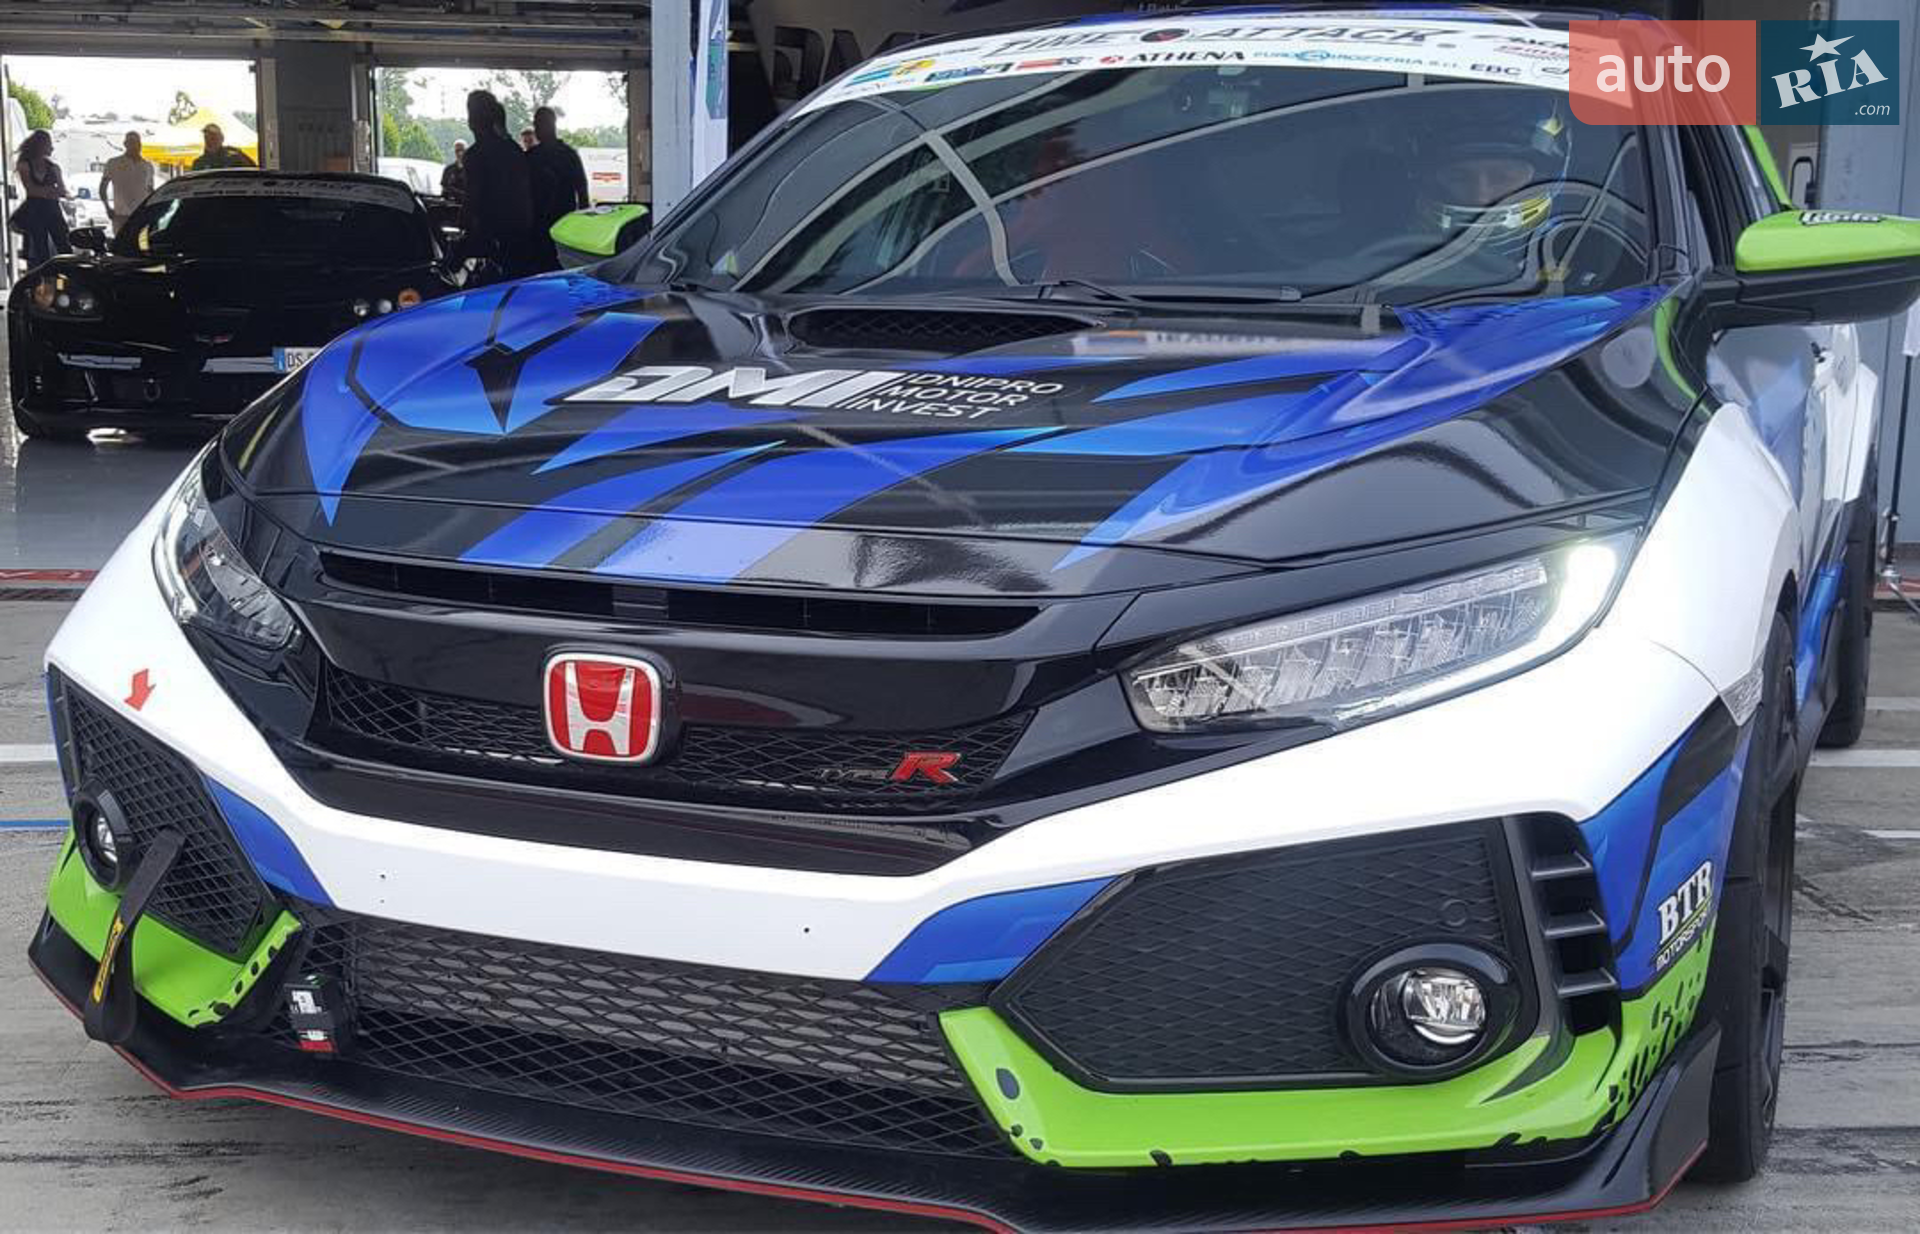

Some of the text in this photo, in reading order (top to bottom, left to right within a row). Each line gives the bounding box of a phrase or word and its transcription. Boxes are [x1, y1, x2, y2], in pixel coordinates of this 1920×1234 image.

[1196, 26, 1462, 45] ATTACK
[1129, 51, 1245, 62] ATHENA
[1470, 63, 1522, 76] EBC
[907, 373, 1064, 395] DNIPRO
[876, 386, 1030, 406] MOTOR
[855, 398, 1002, 419] INVEST
[890, 751, 961, 786] R
[1658, 861, 1712, 945] BTR
